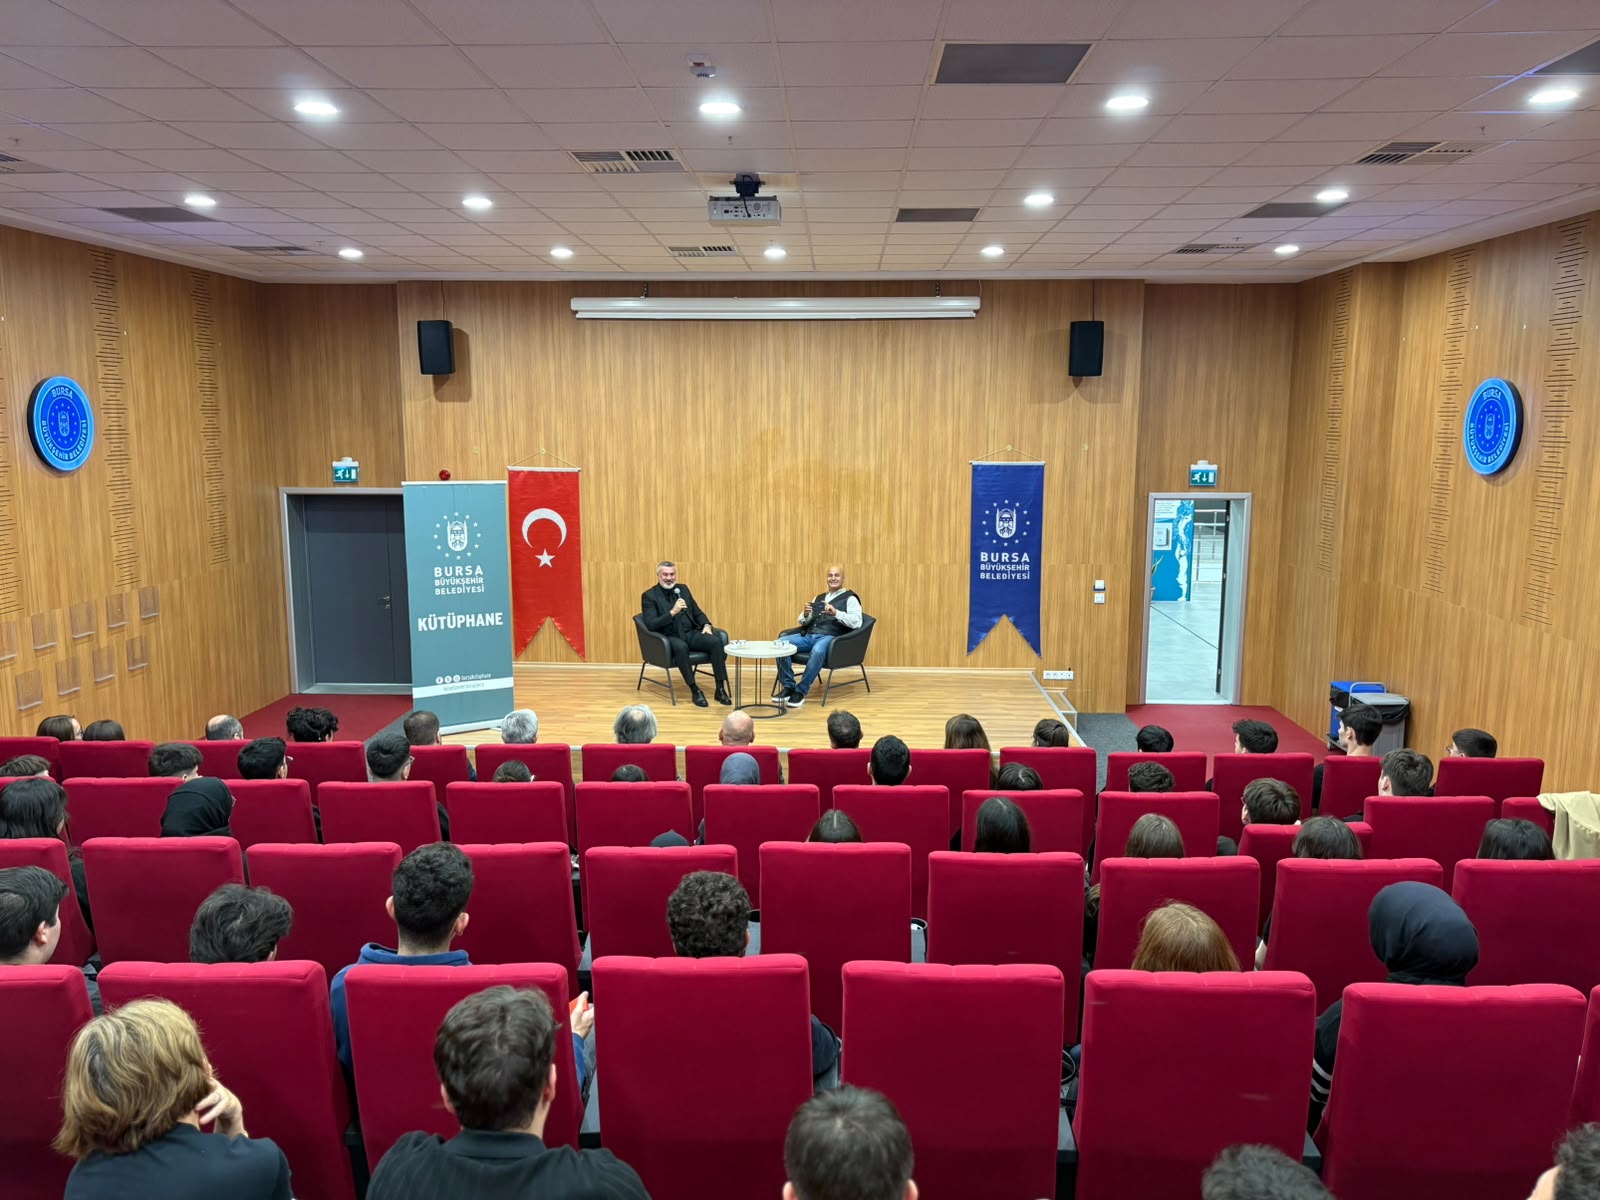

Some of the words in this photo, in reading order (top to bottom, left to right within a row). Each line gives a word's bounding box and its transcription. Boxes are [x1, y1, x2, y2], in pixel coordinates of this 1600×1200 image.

[51, 386, 73, 399] BURSA
[980, 552, 1030, 562] BURSA
[434, 565, 484, 577] BURSA
[980, 562, 1030, 572] BÜYÜKŞEHİR
[980, 571, 1030, 580] BELEDİYESİ
[434, 576, 484, 587] BÜYÜKŞEHİR
[435, 584, 485, 595] BELEDİYESİ
[417, 612, 504, 632] KÜTÜPHANE
